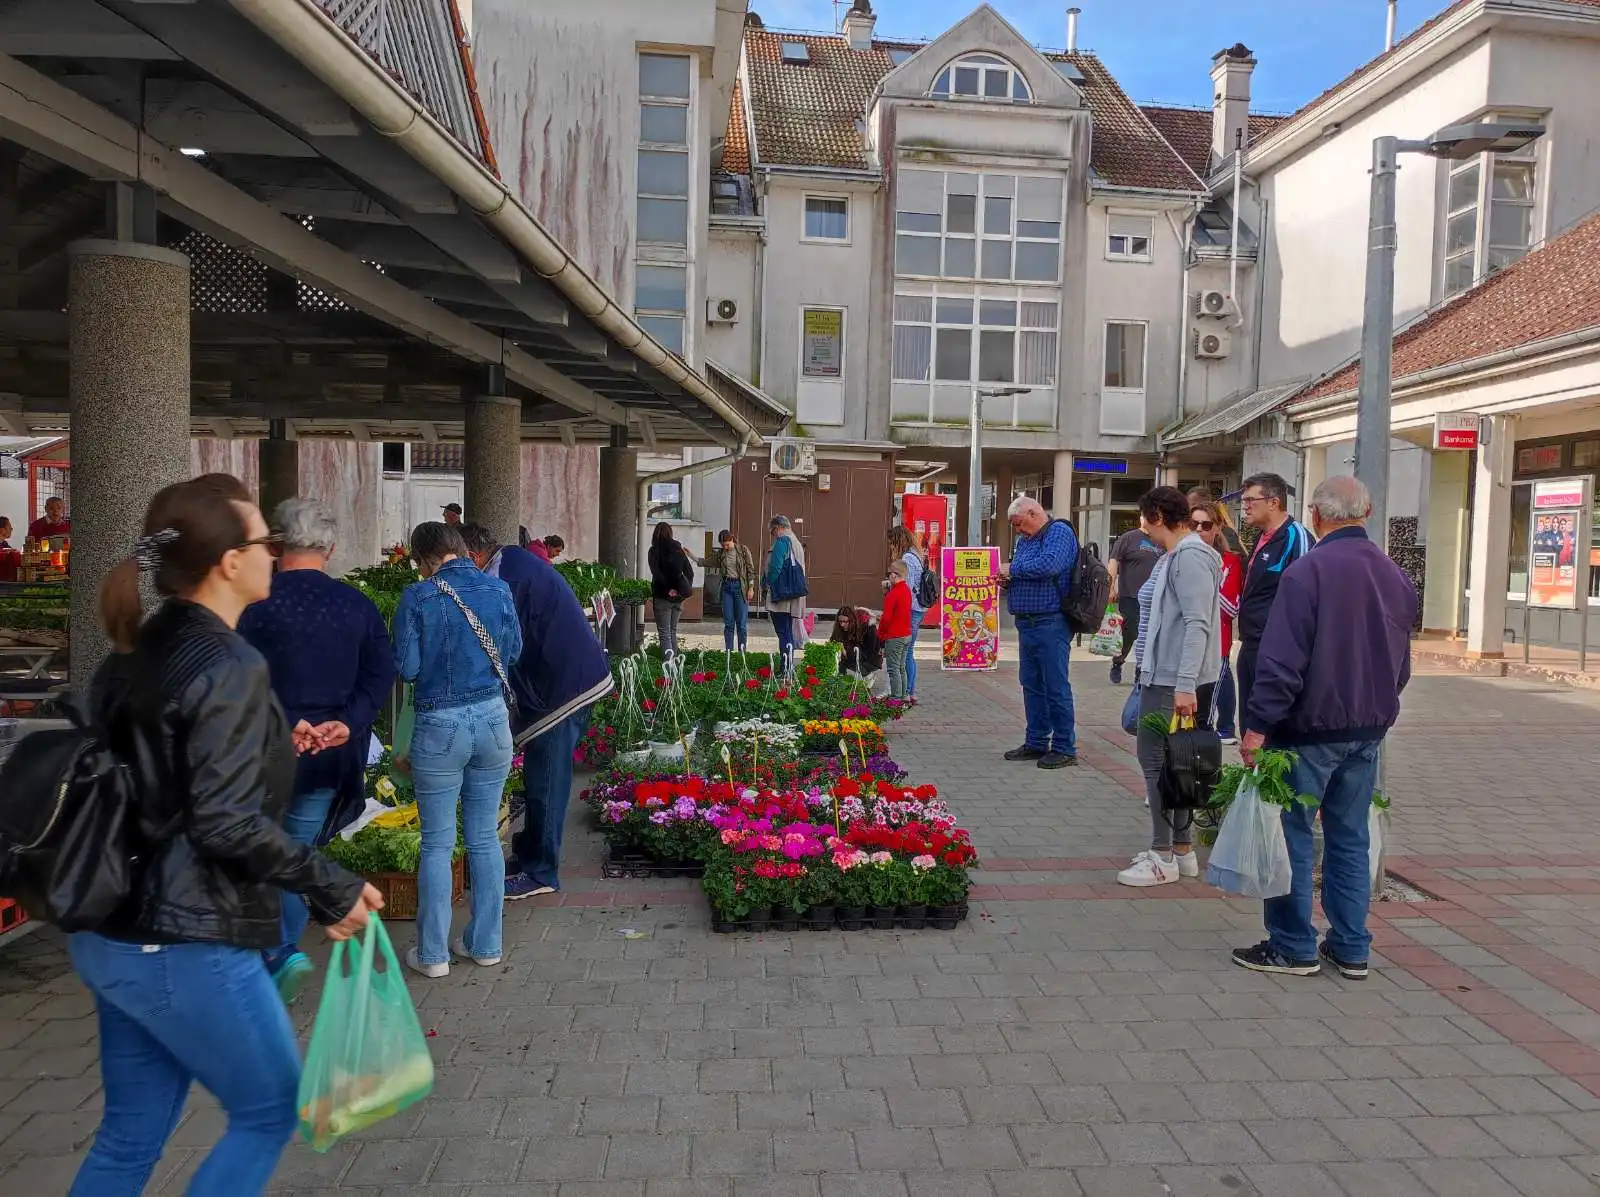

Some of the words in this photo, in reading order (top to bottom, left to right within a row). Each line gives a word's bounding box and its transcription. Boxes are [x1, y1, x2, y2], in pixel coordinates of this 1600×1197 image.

[1444, 435, 1474, 444] Bankomat
[956, 576, 988, 586] CIRCUS
[945, 584, 996, 602] CANDY
